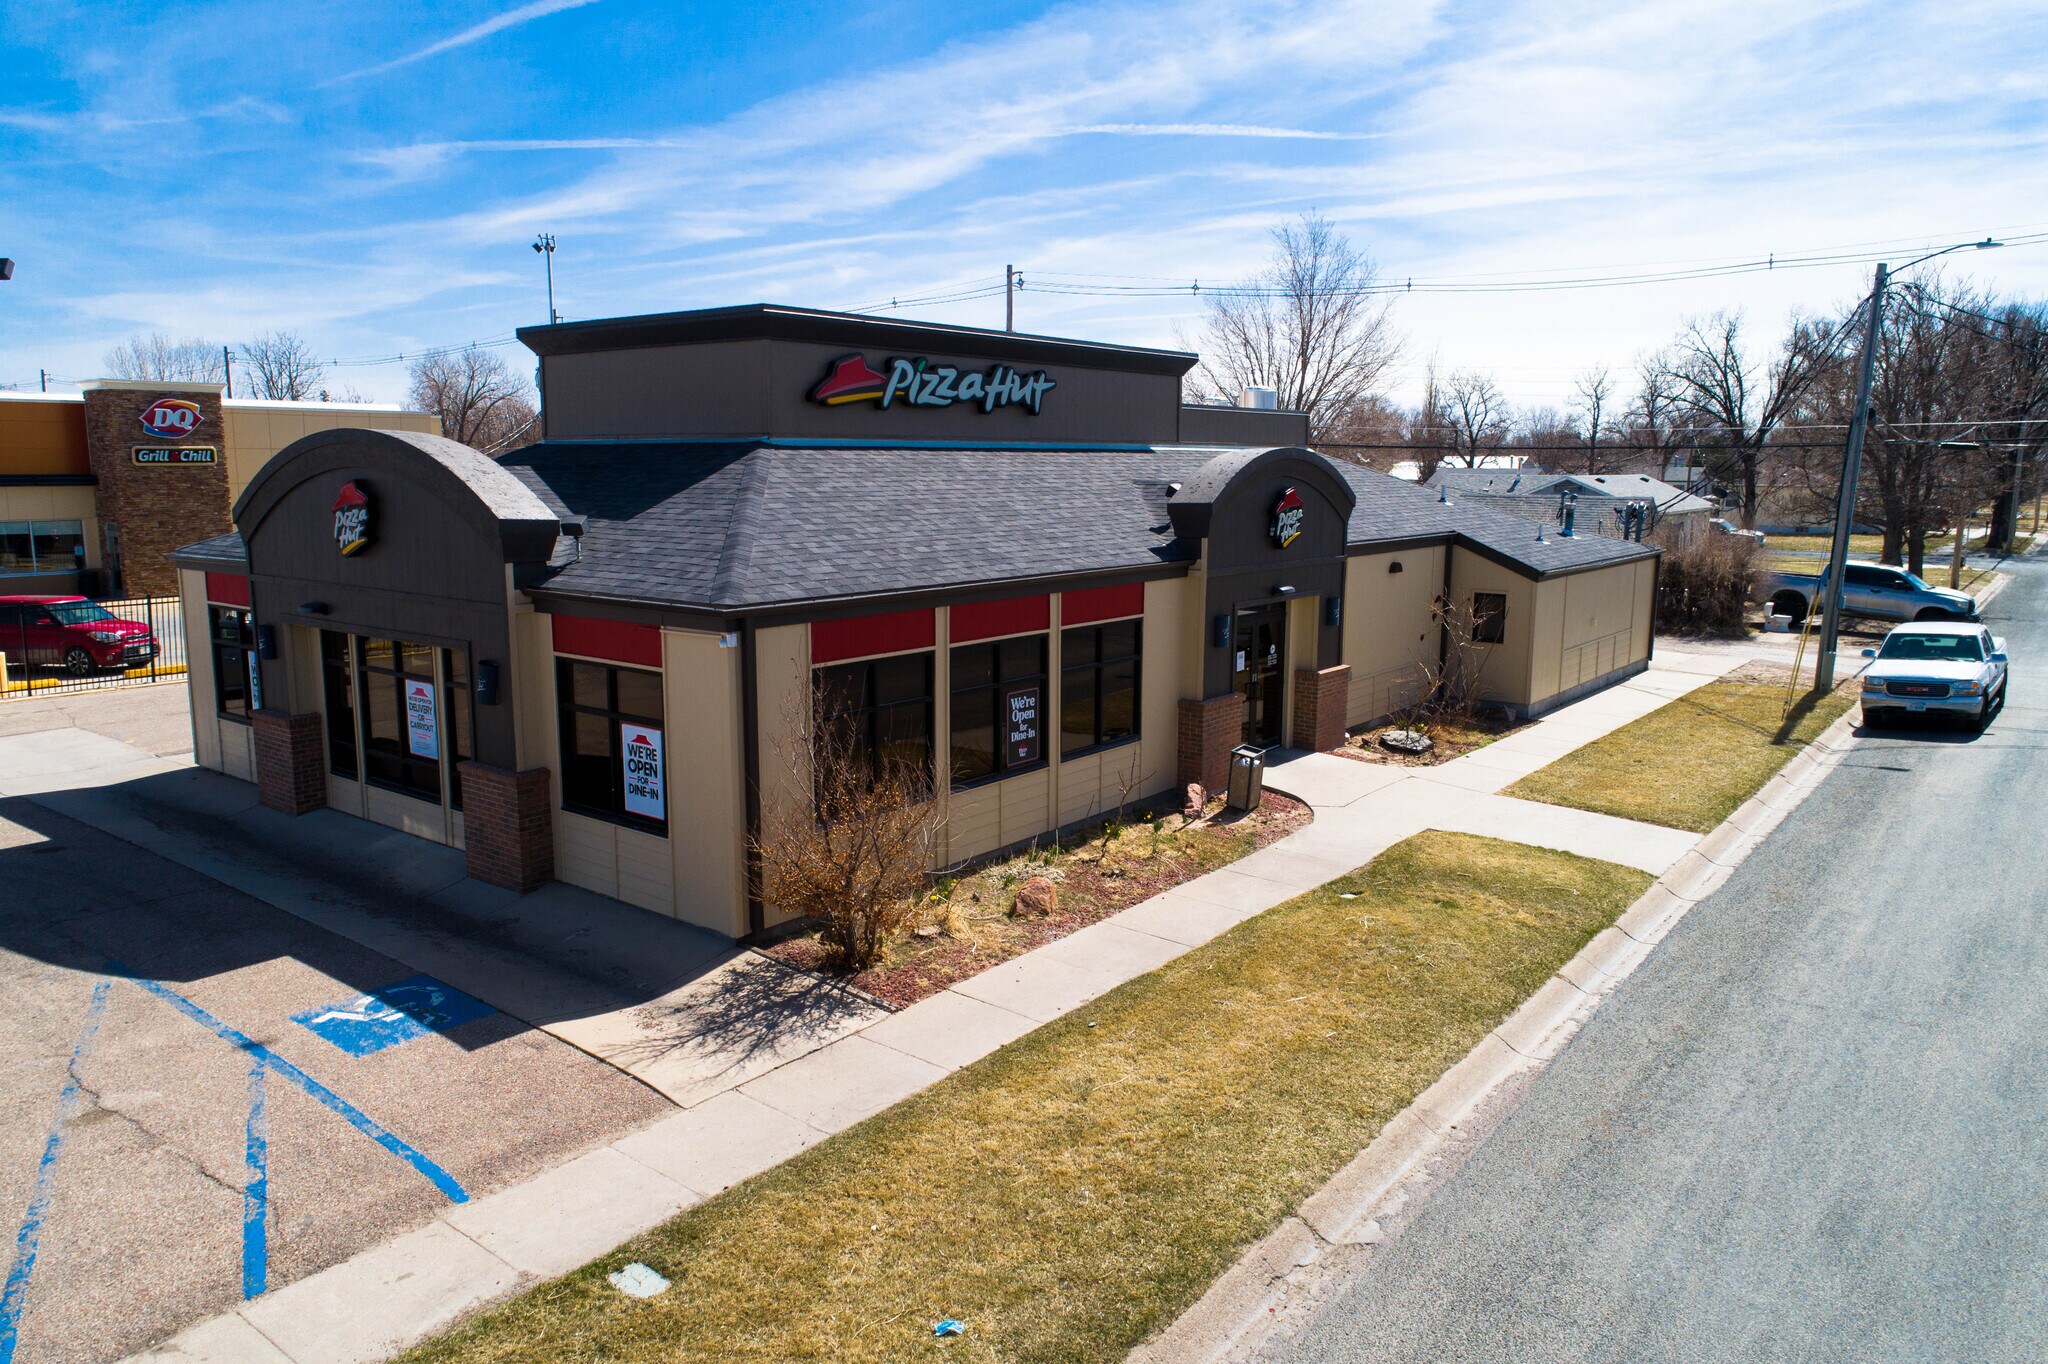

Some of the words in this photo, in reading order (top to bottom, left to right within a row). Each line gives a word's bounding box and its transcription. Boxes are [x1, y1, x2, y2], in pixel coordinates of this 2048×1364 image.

[882, 359, 985, 408] Pizza
[984, 366, 1056, 415] Hut
[153, 408, 194, 430] DQ
[138, 450, 170, 462] Grill
[180, 450, 212, 462] Chill
[334, 506, 368, 539] Pizza
[1277, 509, 1303, 536] Pizza
[339, 523, 364, 549] Hut
[1281, 521, 1300, 543] Hut
[409, 702, 432, 715] DELIVERY
[1010, 696, 1035, 710] We're
[1012, 709, 1035, 724] Open
[410, 720, 433, 732] CARRYOUT
[1011, 728, 1035, 742] Dine-In
[1019, 723, 1028, 731] for
[627, 743, 657, 762] WE'RE
[628, 758, 658, 778] OPEN
[637, 776, 649, 786] FOR
[628, 782, 659, 800] DINE-IN
